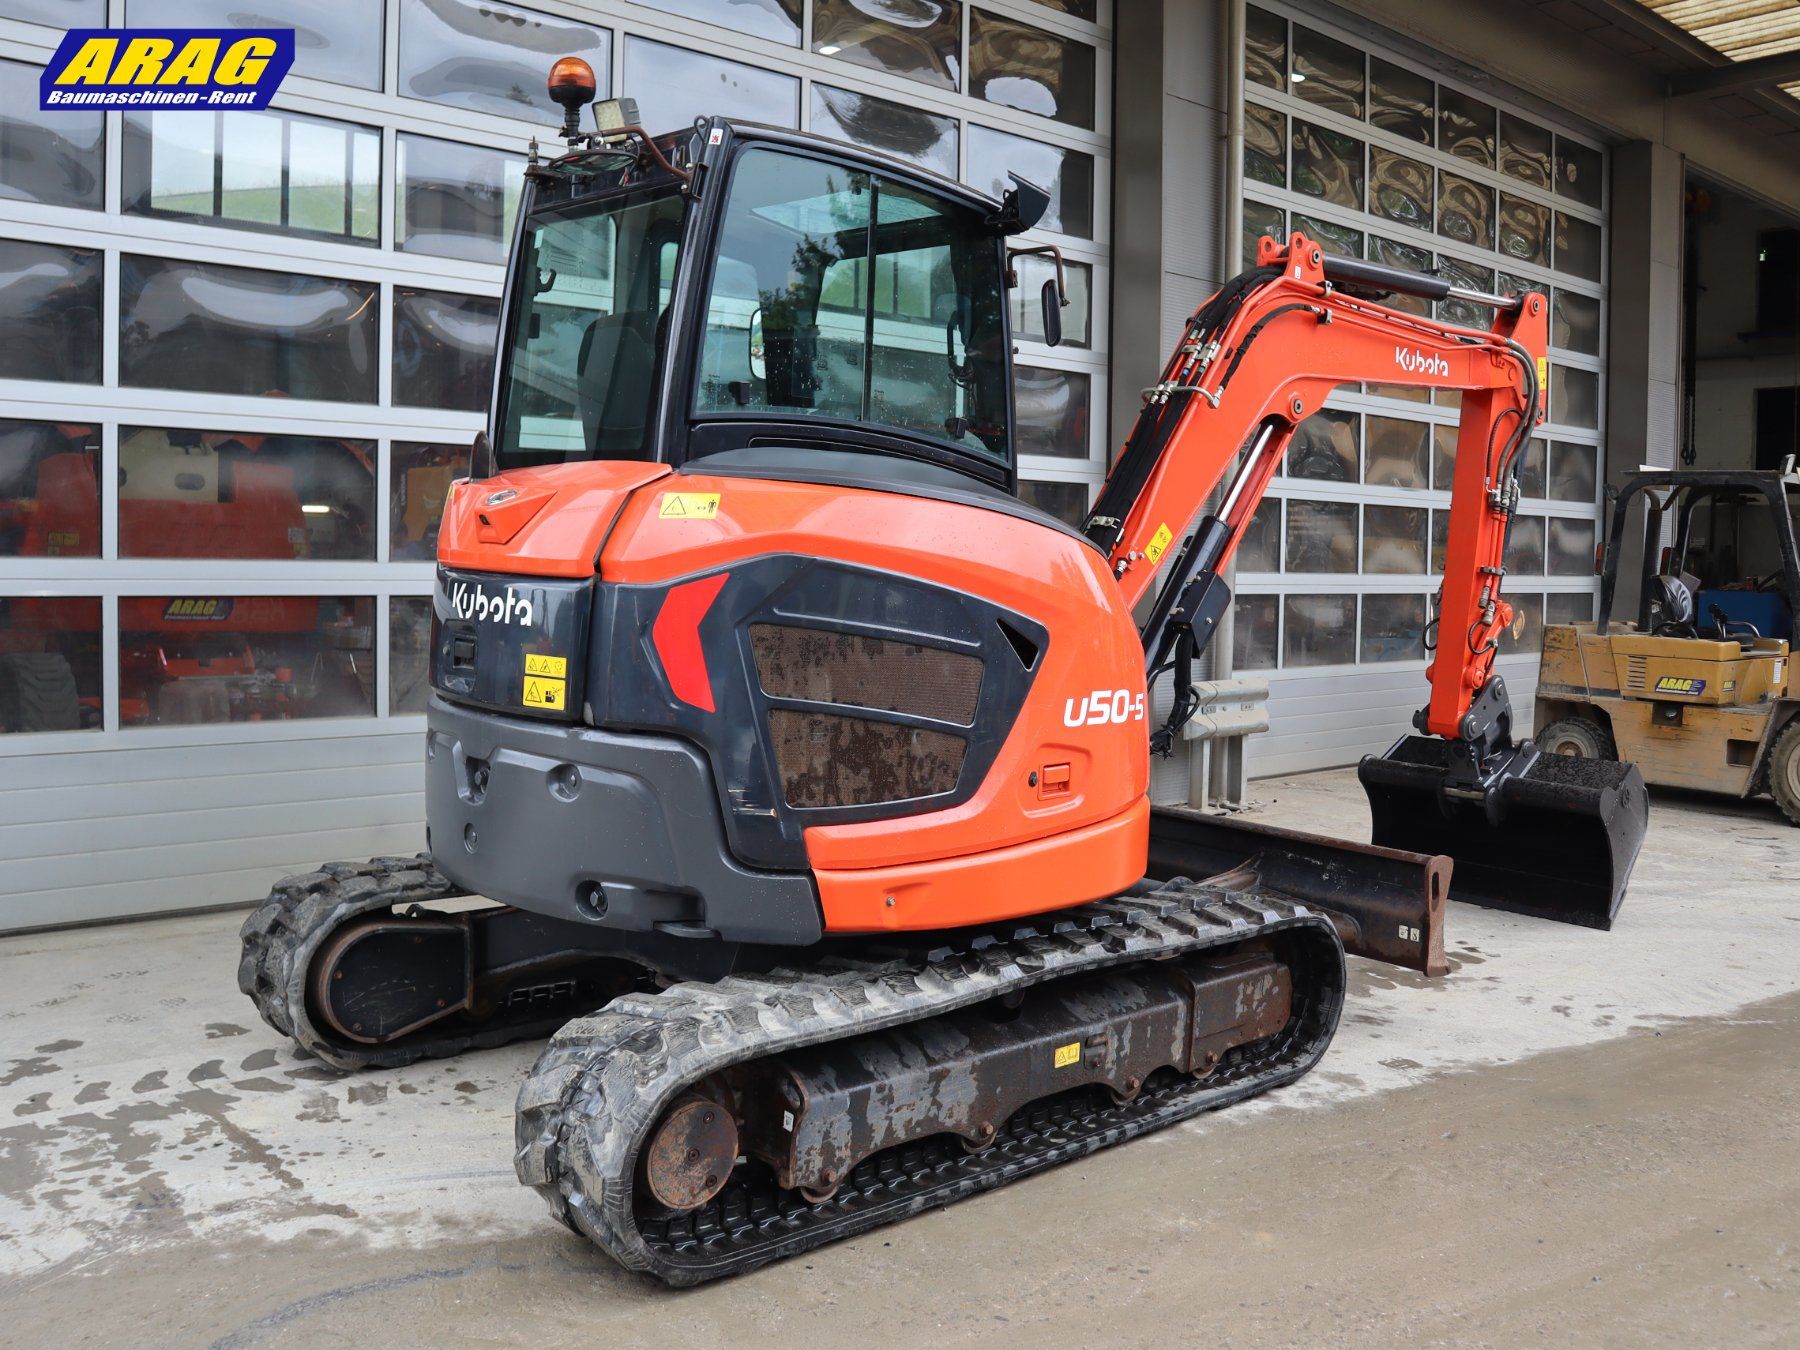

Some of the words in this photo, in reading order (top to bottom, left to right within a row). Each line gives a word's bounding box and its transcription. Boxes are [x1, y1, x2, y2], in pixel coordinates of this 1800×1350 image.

[1395, 346, 1449, 377] Kubota
[167, 599, 218, 615] ARAG
[452, 582, 533, 627] Kubota
[1657, 677, 1693, 691] ARAG
[1063, 689, 1144, 727] U50-5
